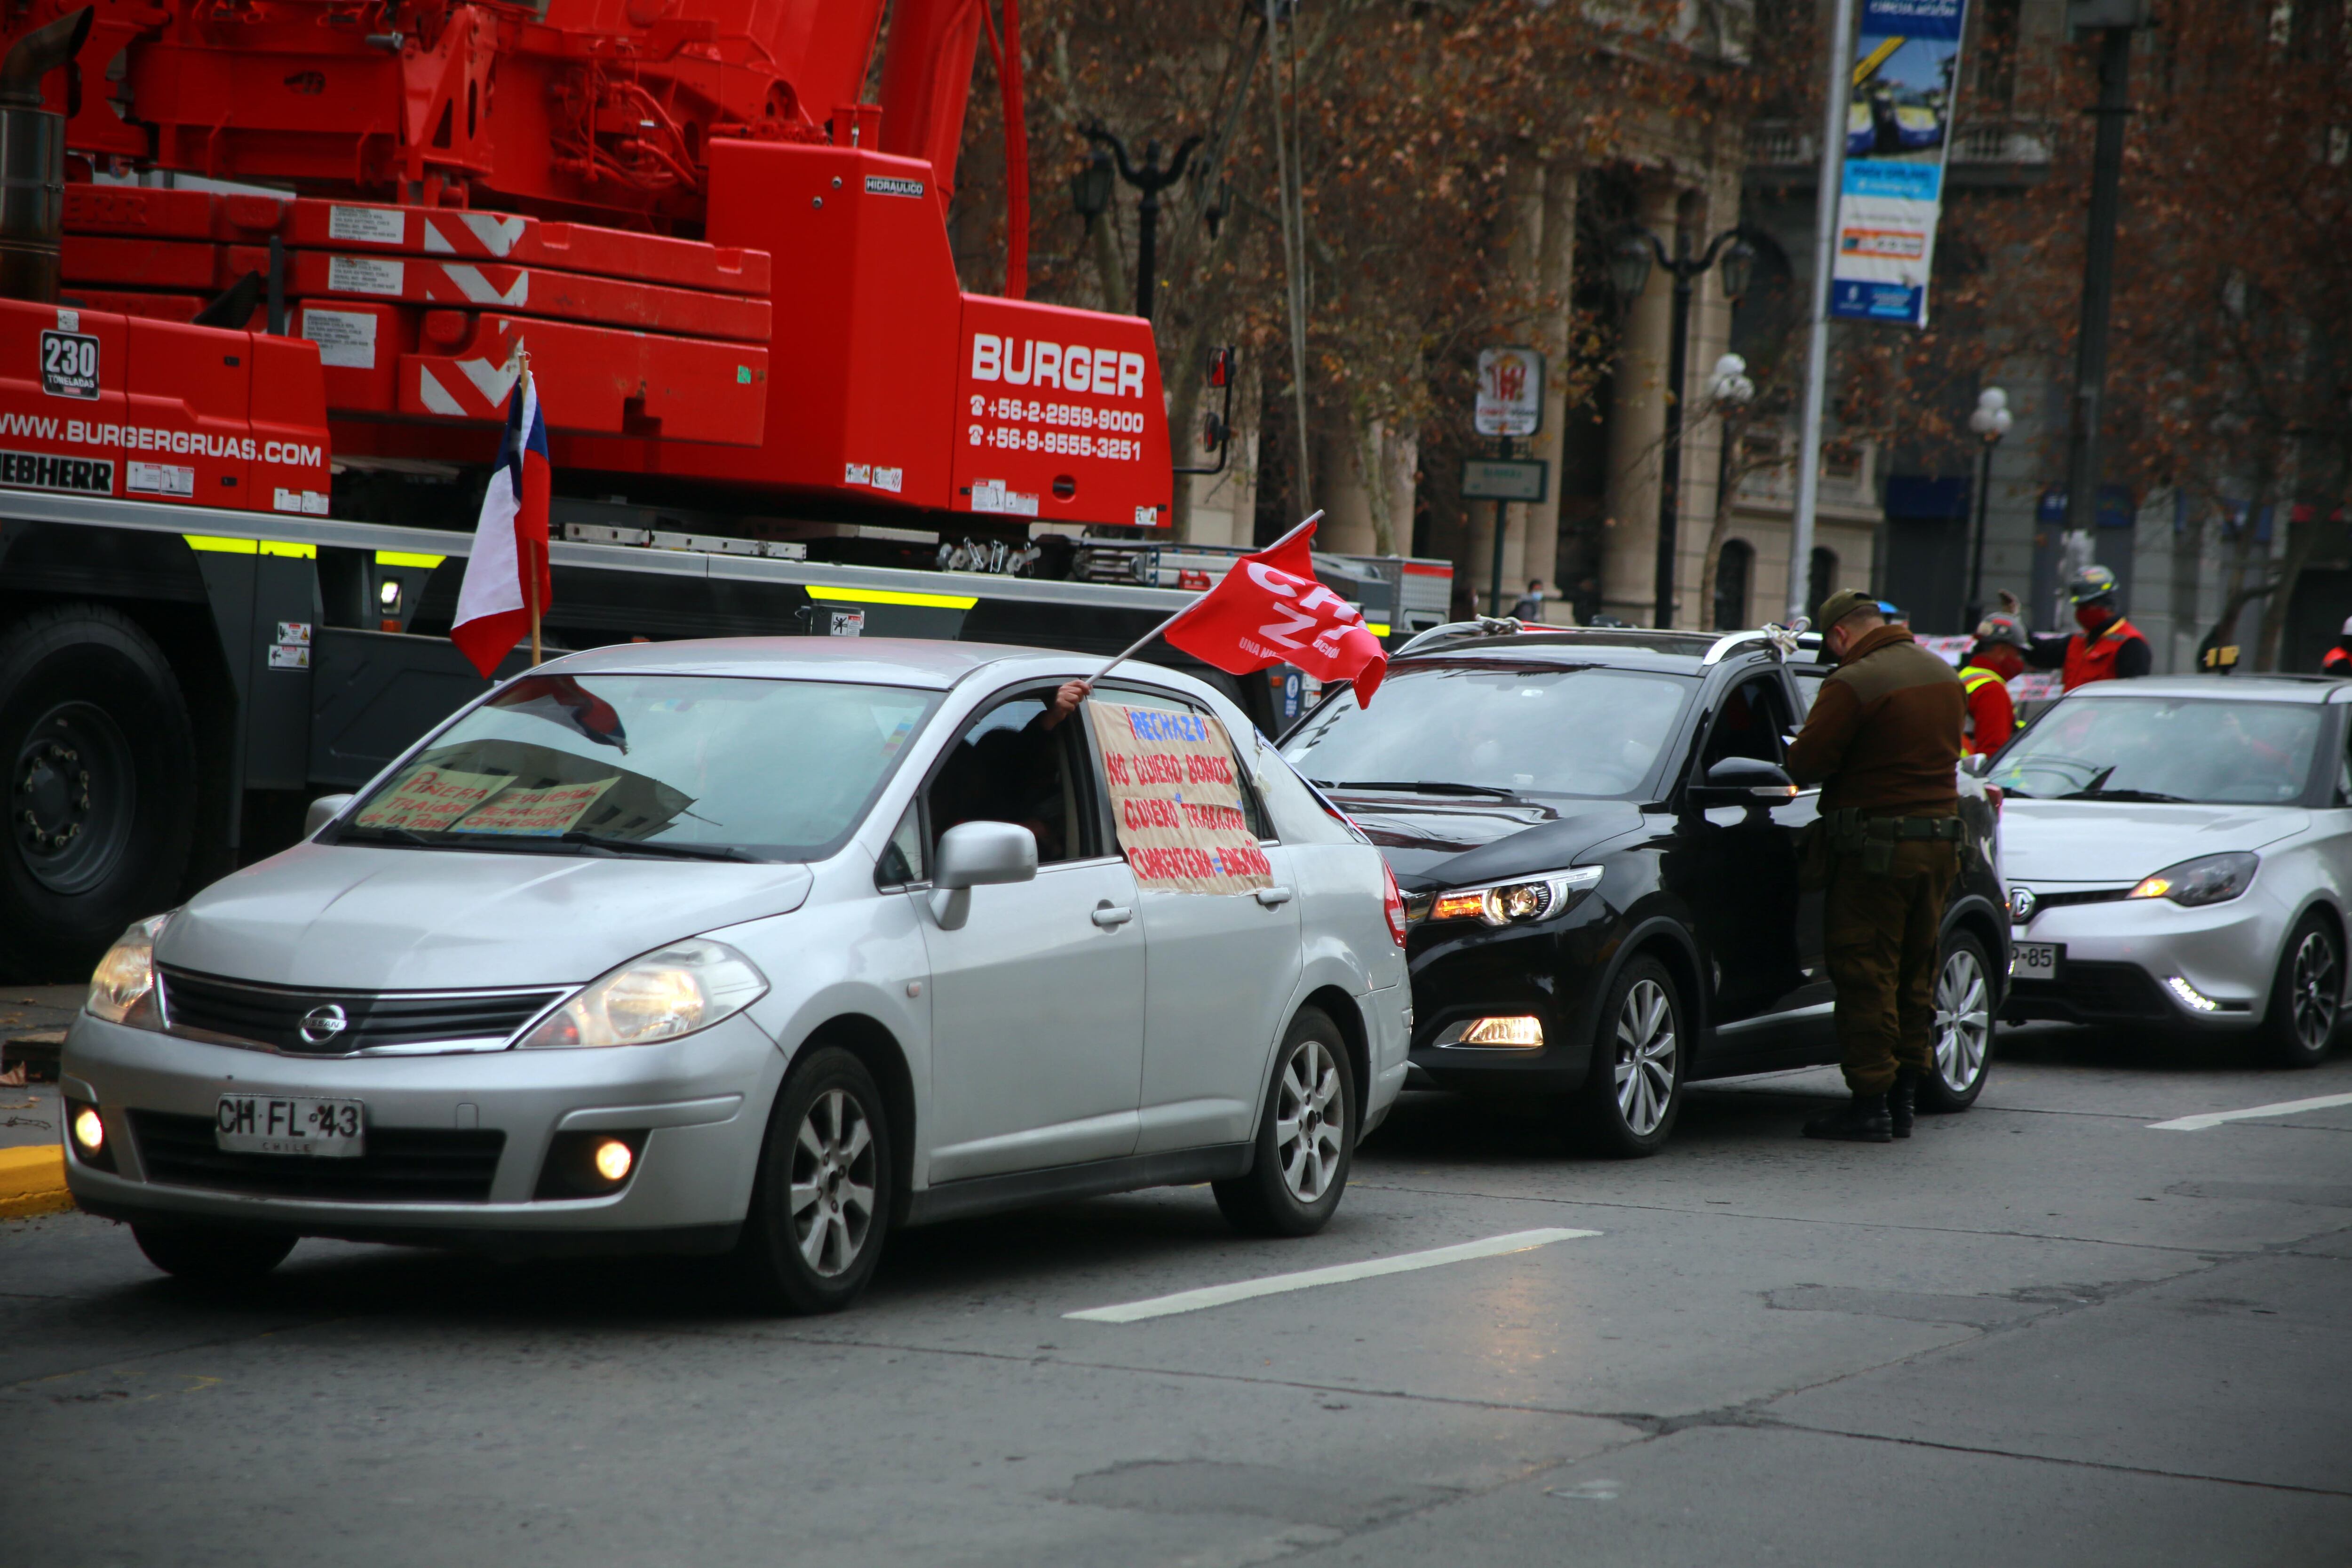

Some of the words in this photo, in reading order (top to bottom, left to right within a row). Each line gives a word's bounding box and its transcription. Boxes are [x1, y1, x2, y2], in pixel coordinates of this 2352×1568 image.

[867, 179, 923, 194] HIDRAULICO
[45, 338, 95, 377] 230
[972, 333, 1145, 398] BURGER
[48, 374, 94, 388] TONELADAS
[1239, 637, 1260, 656] UNA
[1106, 751, 1129, 786] NO
[1133, 753, 1183, 786] QUIERO
[1185, 754, 1233, 785] BONOS
[401, 772, 489, 800] PIÑERA
[386, 814, 408, 823] LA
[1124, 798, 1180, 832] QUIERO
[302, 1019, 340, 1028] NISSAN
[218, 1099, 254, 1134] CH
[268, 1102, 305, 1136] FL
[319, 1105, 358, 1137] 43
[262, 1141, 311, 1151] CHILE
